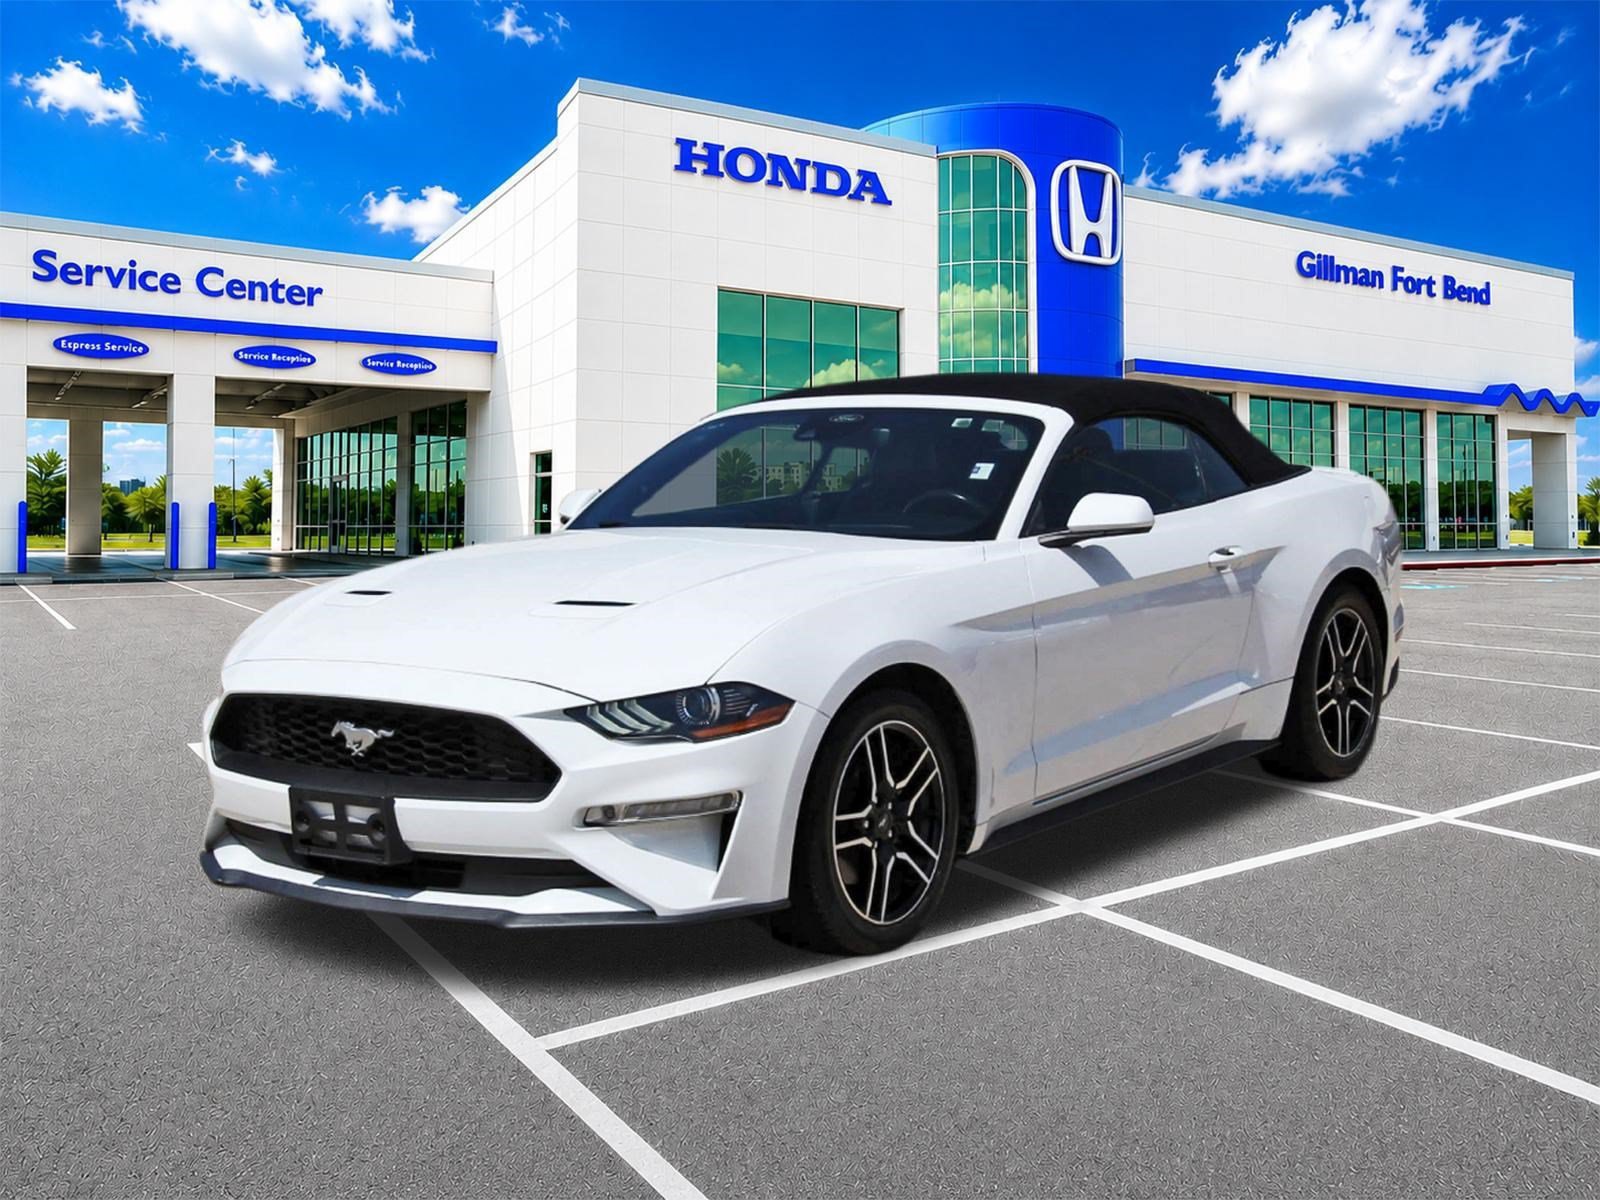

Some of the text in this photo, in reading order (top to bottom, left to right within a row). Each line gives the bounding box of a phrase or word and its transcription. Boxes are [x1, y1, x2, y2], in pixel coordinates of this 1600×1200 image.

[673, 137, 893, 206] HONDA
[32, 249, 324, 307] Service Center
[1296, 250, 1491, 305] Gillman Fort Bend
[104, 342, 144, 353] Service
[238, 351, 269, 361] Service
[366, 358, 395, 368] Service
